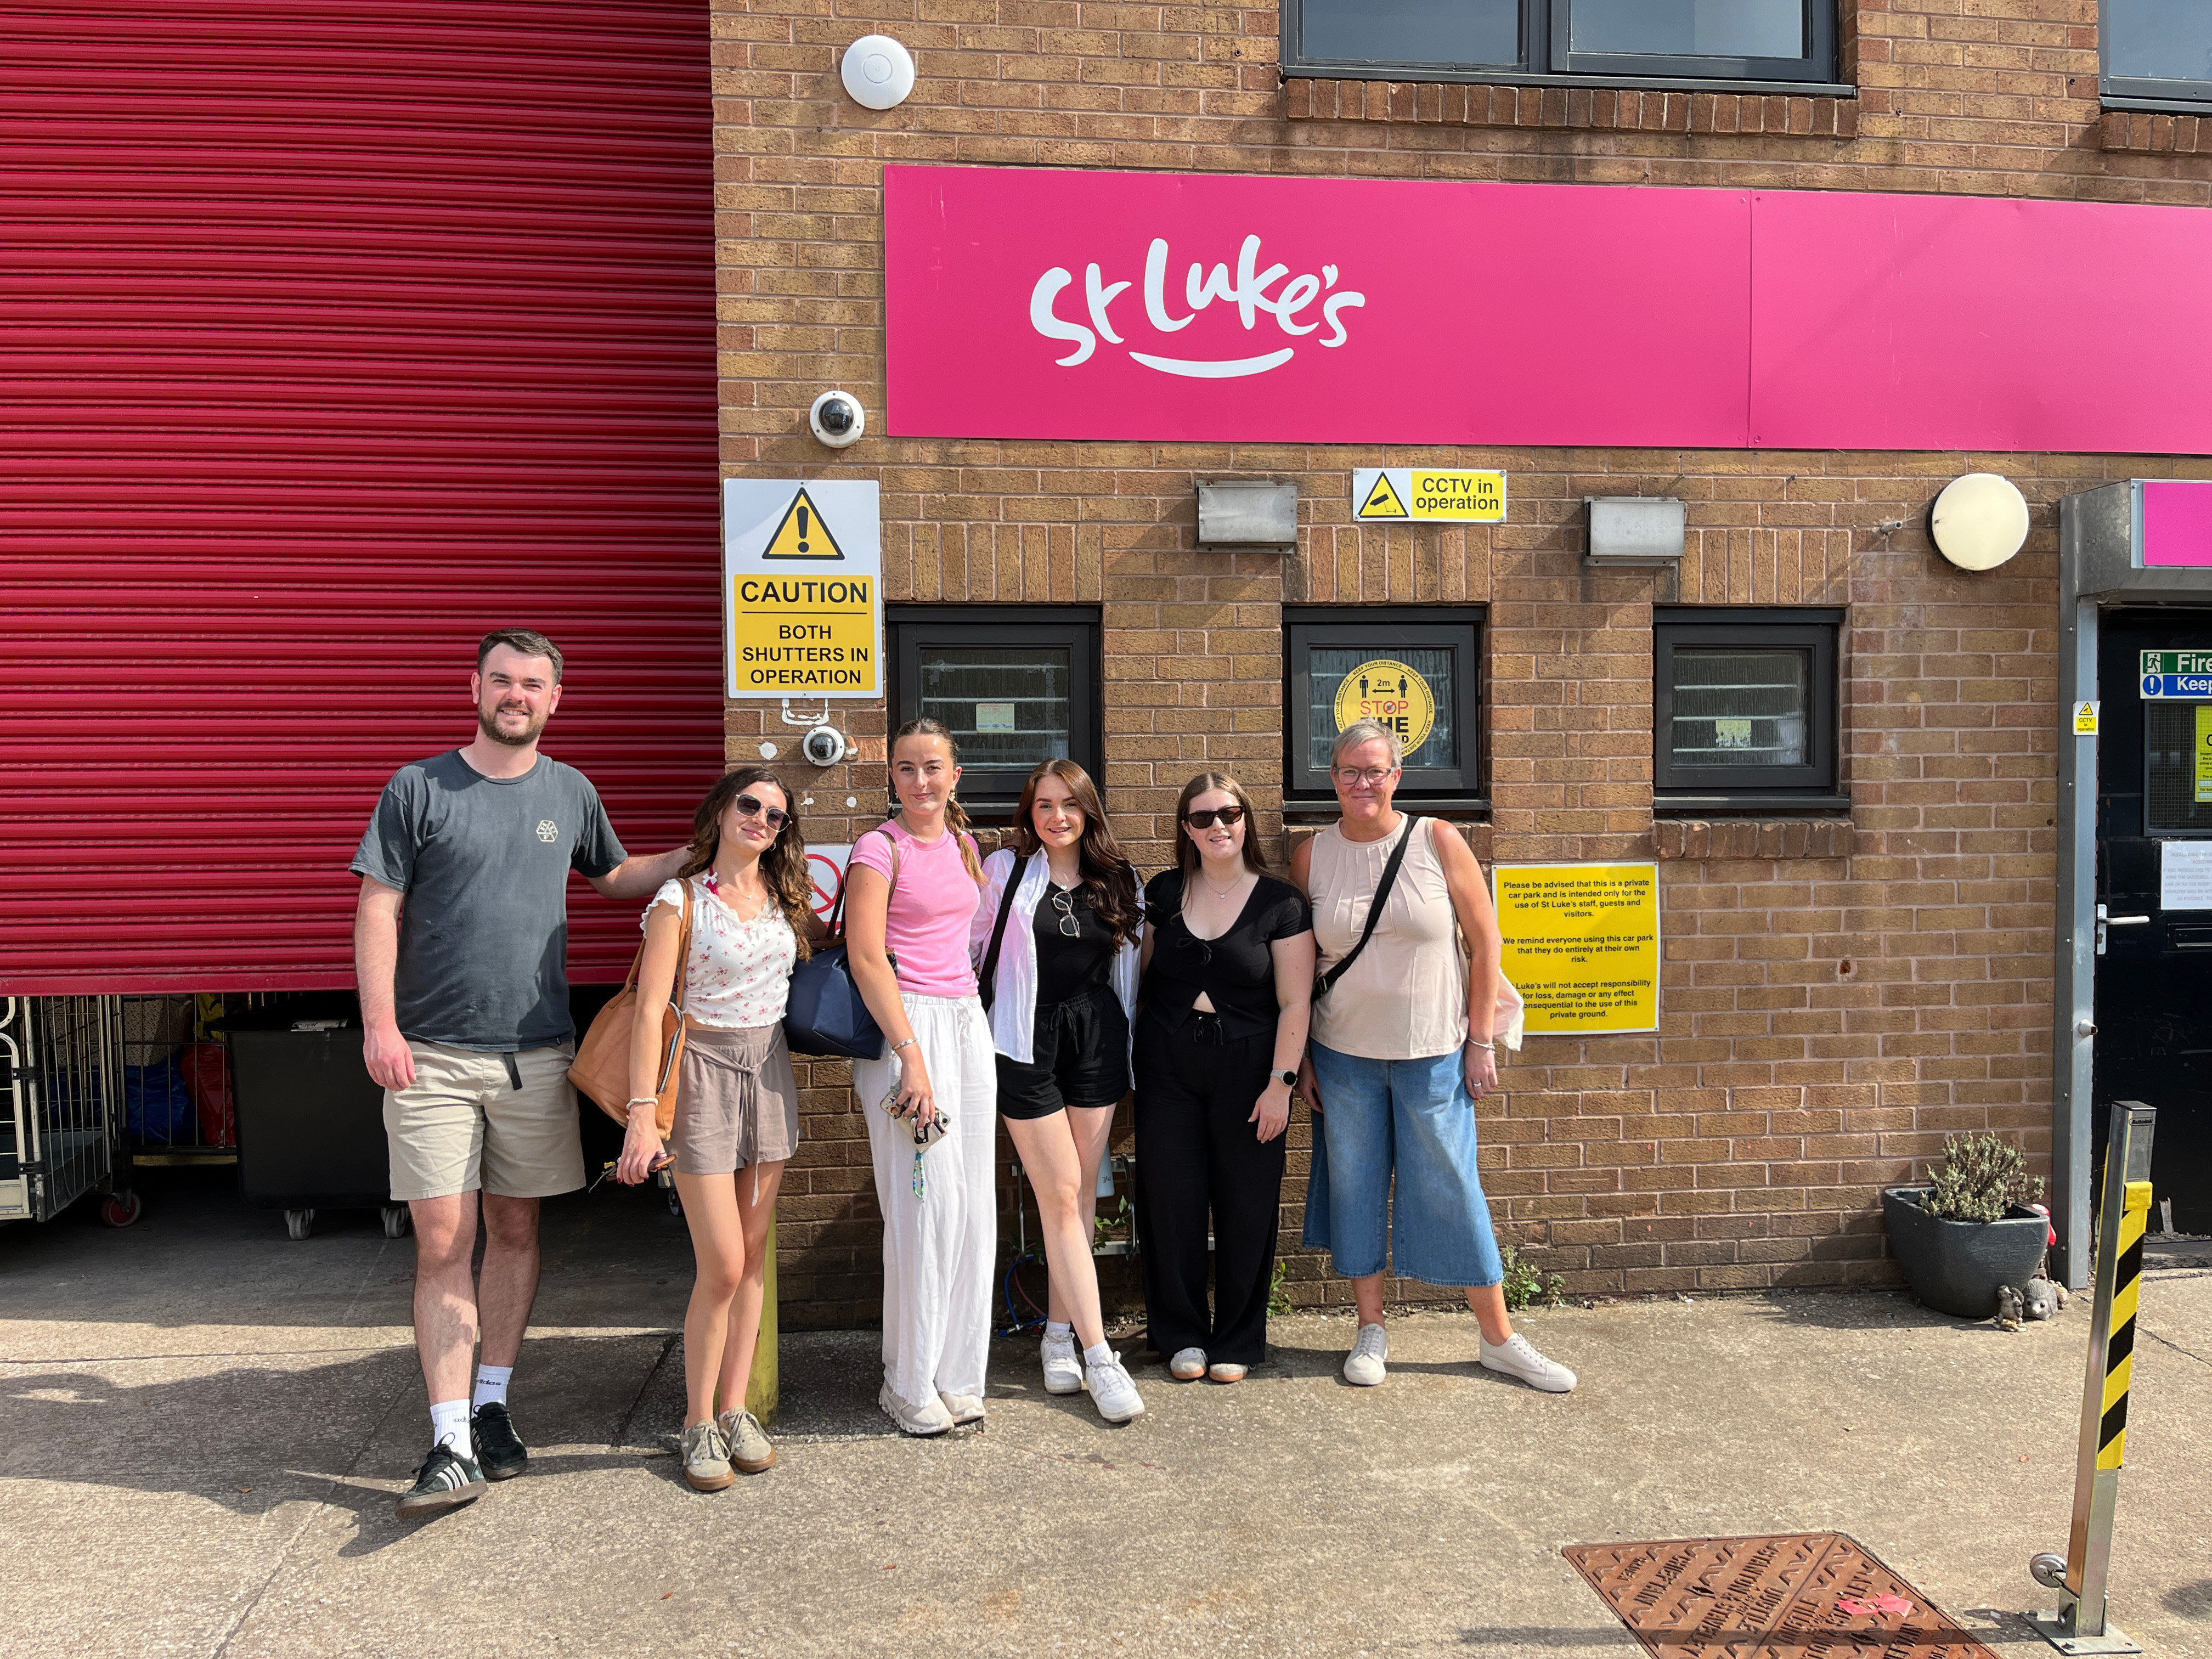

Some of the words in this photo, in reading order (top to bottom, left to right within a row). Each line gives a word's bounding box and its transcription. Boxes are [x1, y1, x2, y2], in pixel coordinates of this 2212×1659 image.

[1030, 263, 1132, 366] St
[1144, 234, 1365, 347] Luke's
[1423, 478, 1472, 493] CCTV
[1479, 479, 1493, 493] in
[1417, 495, 1499, 512] operation
[741, 582, 867, 603] CAUTION
[779, 625, 832, 639] BOTH
[742, 647, 844, 662] SHUTTERS
[851, 648, 868, 662] IN
[751, 670, 861, 684] OPERATION
[1360, 701, 1409, 715] STOP
[1361, 717, 1409, 732] HE
[1401, 744, 1417, 755] DISTAN
[1523, 891, 1541, 900] park
[1579, 900, 1598, 908] staff,
[1584, 935, 1605, 944] using
[1637, 934, 1654, 943] park
[1565, 945, 1593, 954] entirely
[1600, 979, 1651, 988] responsibility
[1523, 1001, 1573, 1009] onsequential
[1550, 1011, 1576, 1019] private
[1578, 1010, 1608, 1019] ground.
